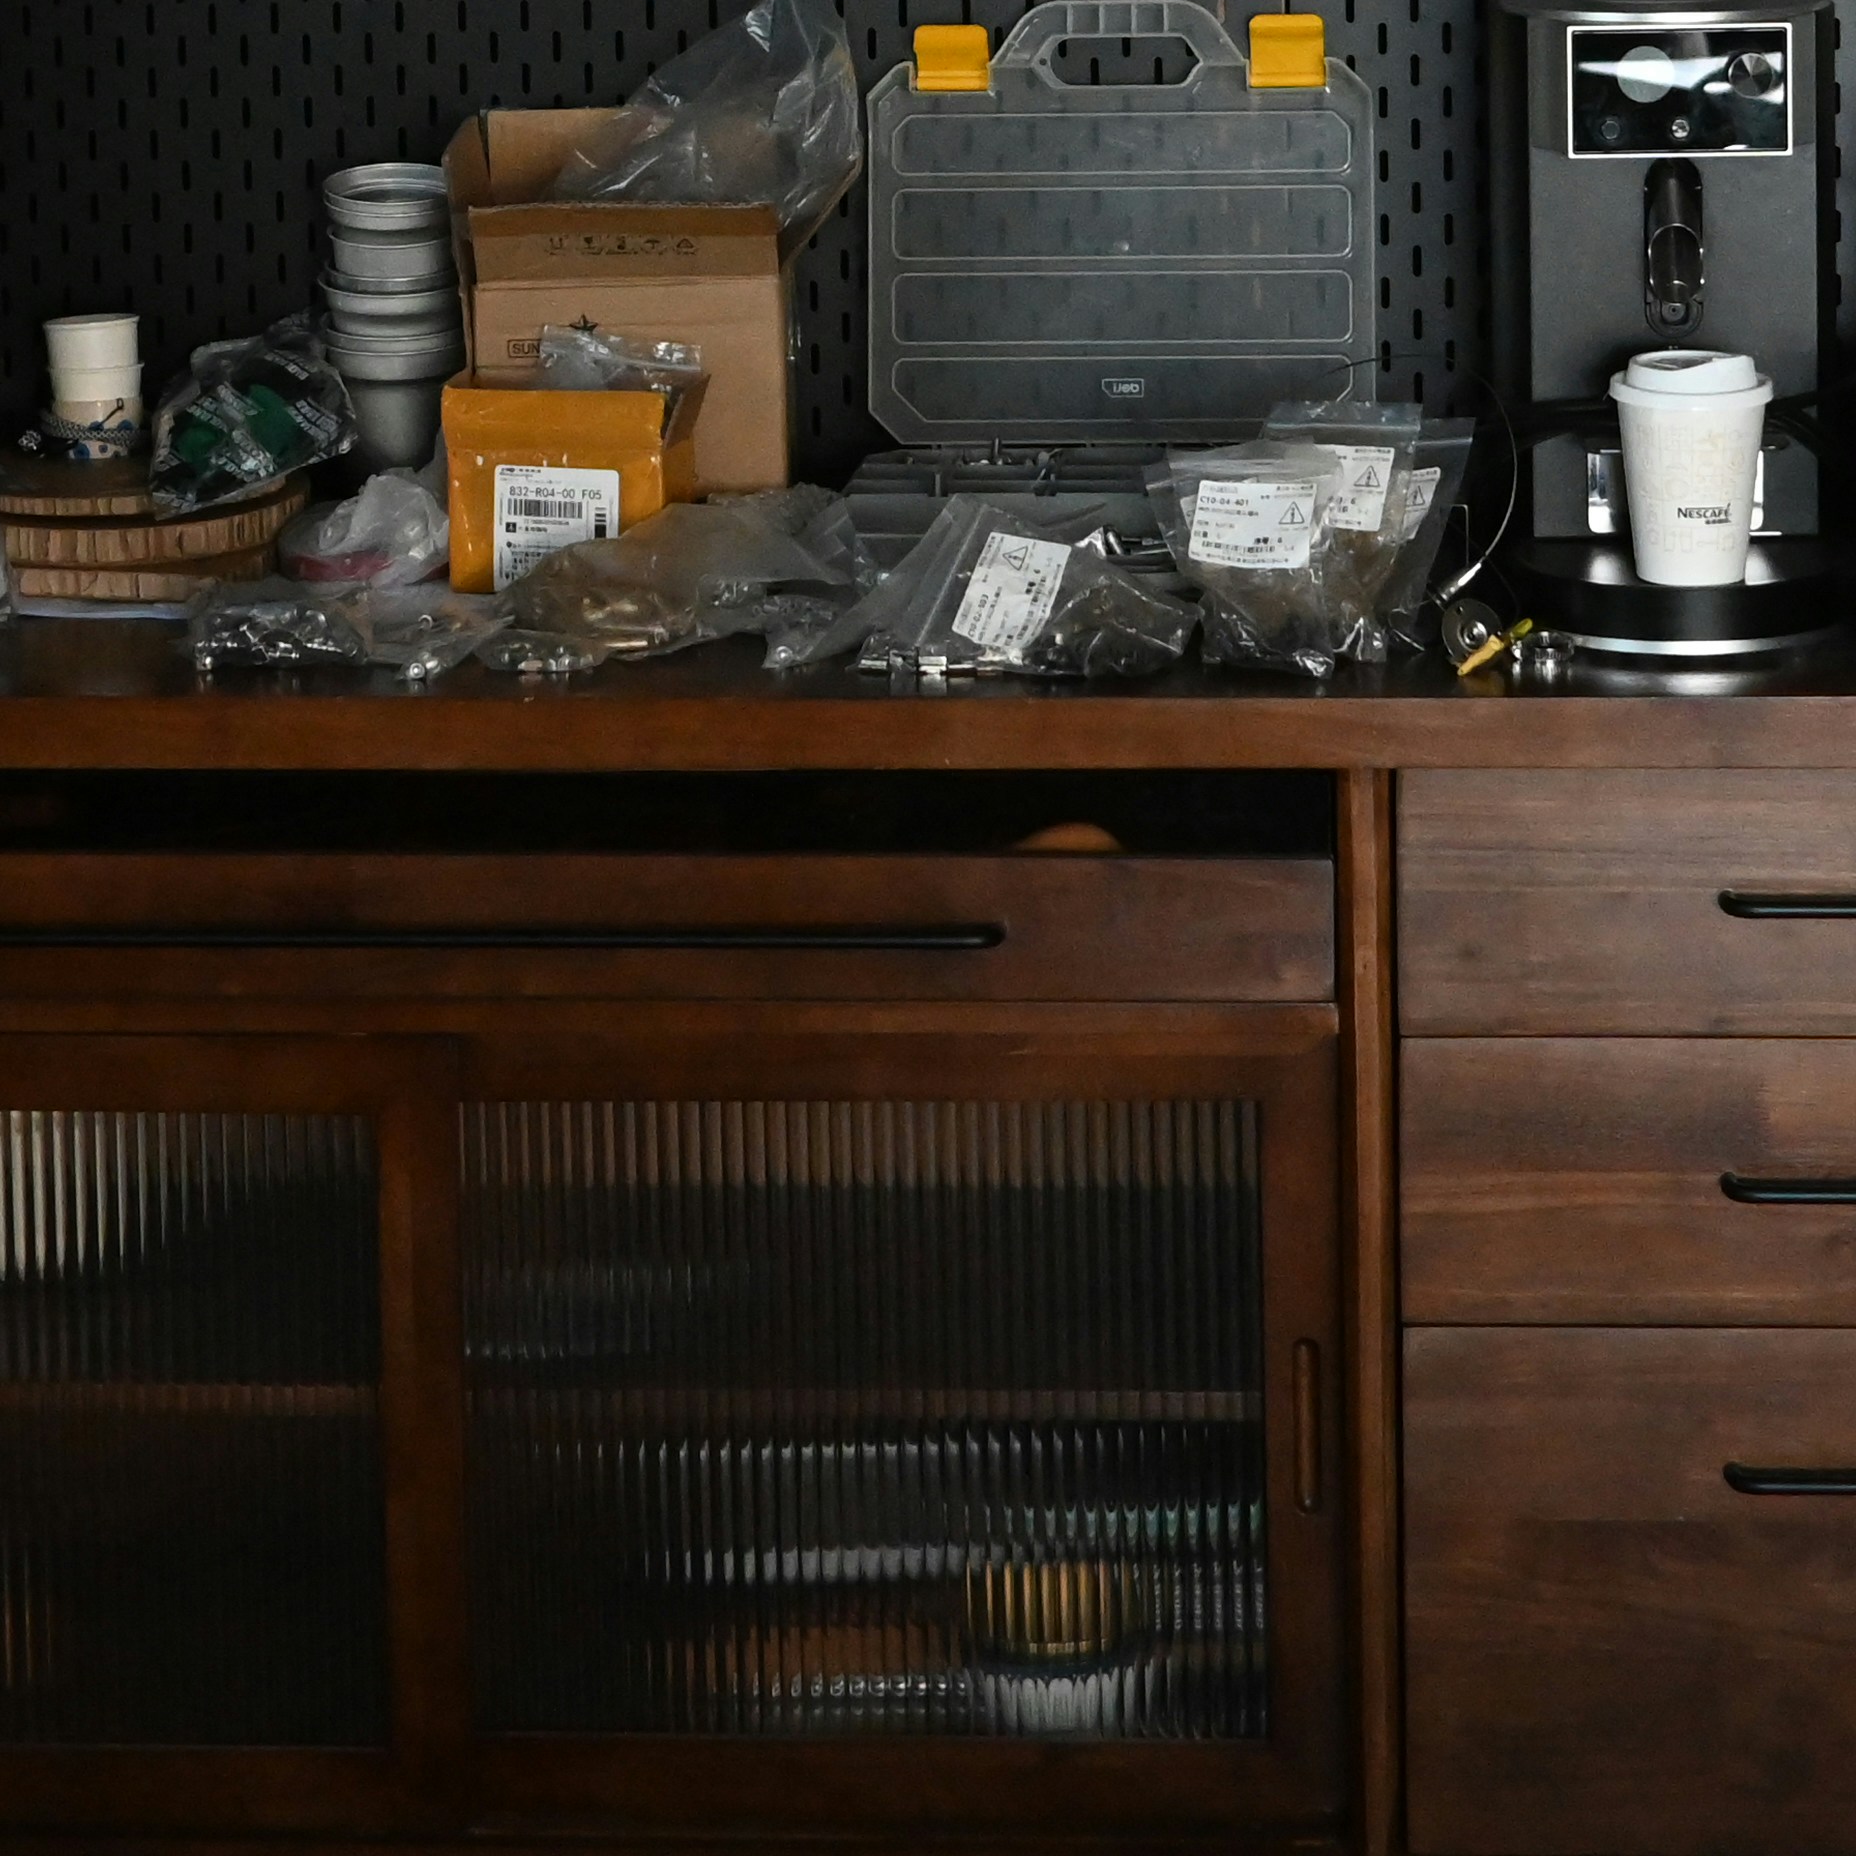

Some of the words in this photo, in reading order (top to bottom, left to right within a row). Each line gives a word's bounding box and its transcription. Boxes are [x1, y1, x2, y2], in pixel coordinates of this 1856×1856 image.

[509, 485, 576, 499] 832-R04-00
[581, 489, 602, 500] F05
[1677, 502, 1732, 519] NESCAFÉ
